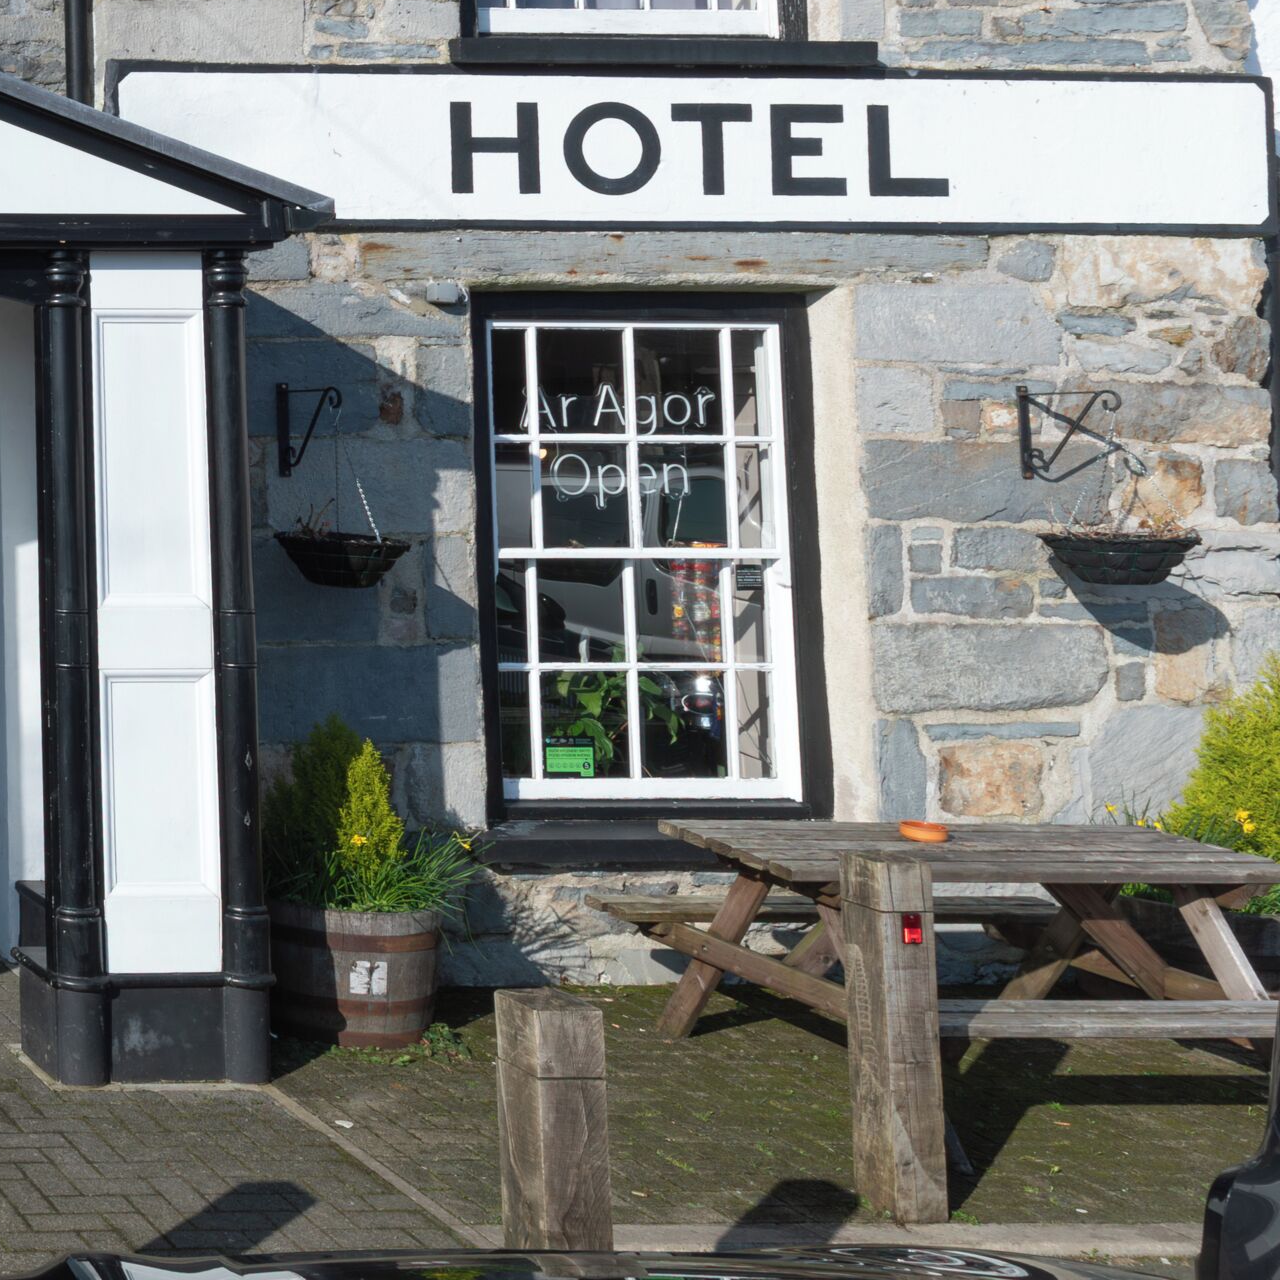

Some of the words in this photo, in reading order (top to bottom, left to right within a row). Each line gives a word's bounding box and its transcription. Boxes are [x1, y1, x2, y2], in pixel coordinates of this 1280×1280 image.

[449, 101, 950, 197] HOTEL
[522, 384, 578, 428] Ar
[592, 384, 716, 436] Agor
[553, 453, 690, 508] Open
